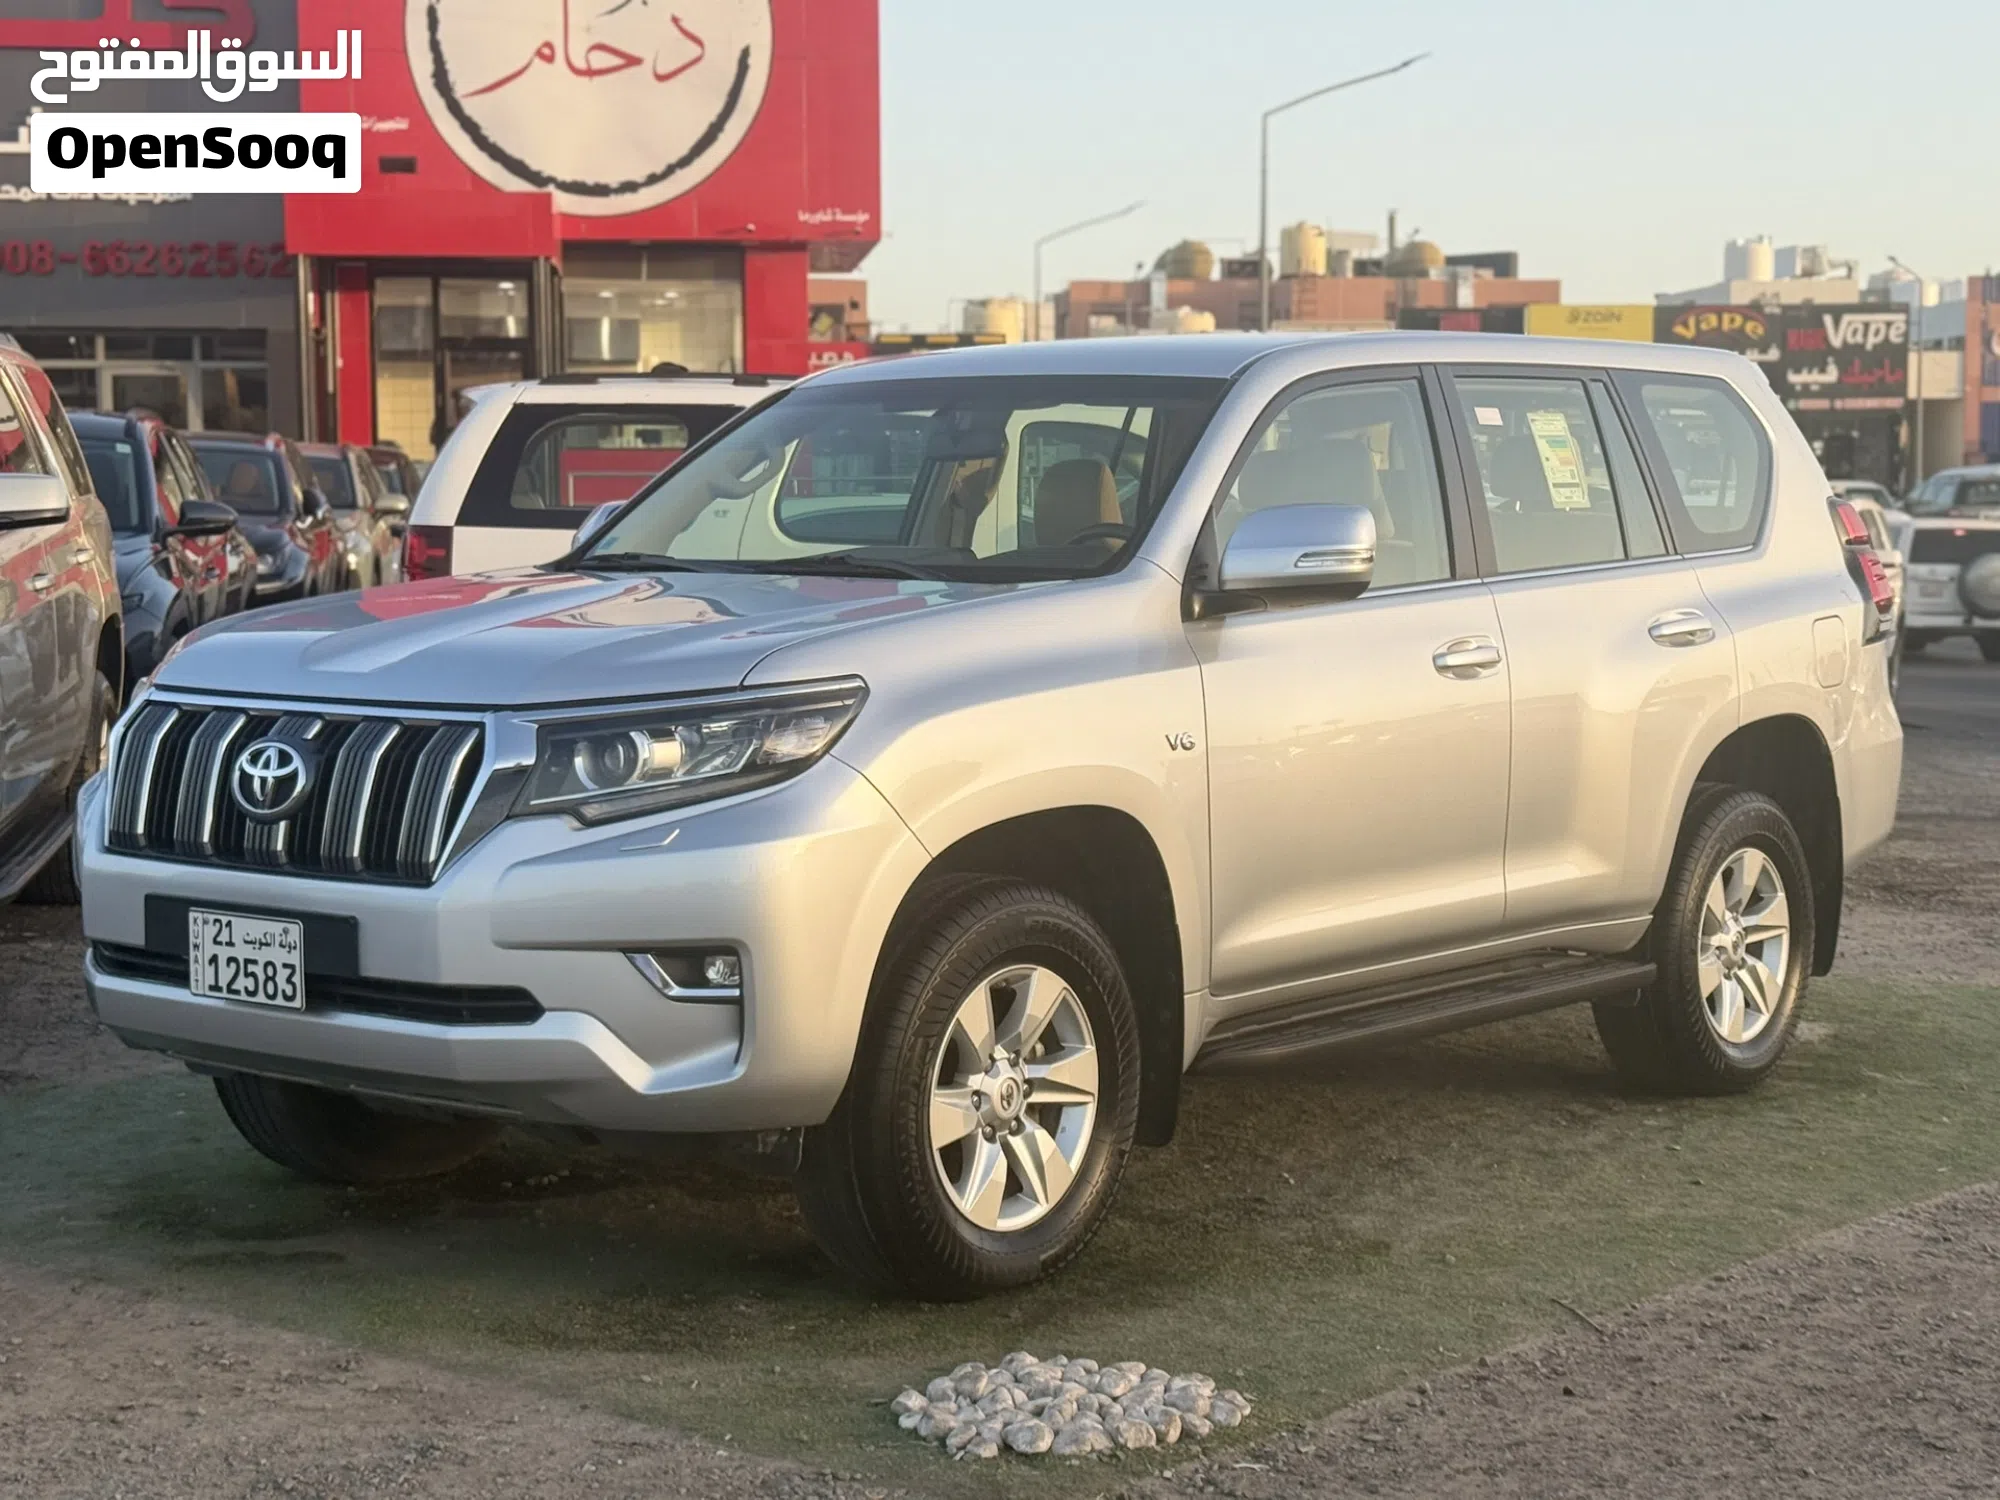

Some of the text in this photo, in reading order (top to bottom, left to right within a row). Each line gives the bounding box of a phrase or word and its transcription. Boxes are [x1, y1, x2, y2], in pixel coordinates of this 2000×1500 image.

[0, 239, 296, 278] 08-66262562
[1672, 310, 1766, 341] Vape
[1822, 313, 1907, 351] Vape
[1164, 731, 1196, 752] V6
[212, 918, 236, 948] 21
[243, 928, 298, 954] دولة الكويت
[193, 915, 201, 991] KUWAIT
[208, 953, 298, 1003] 12583
